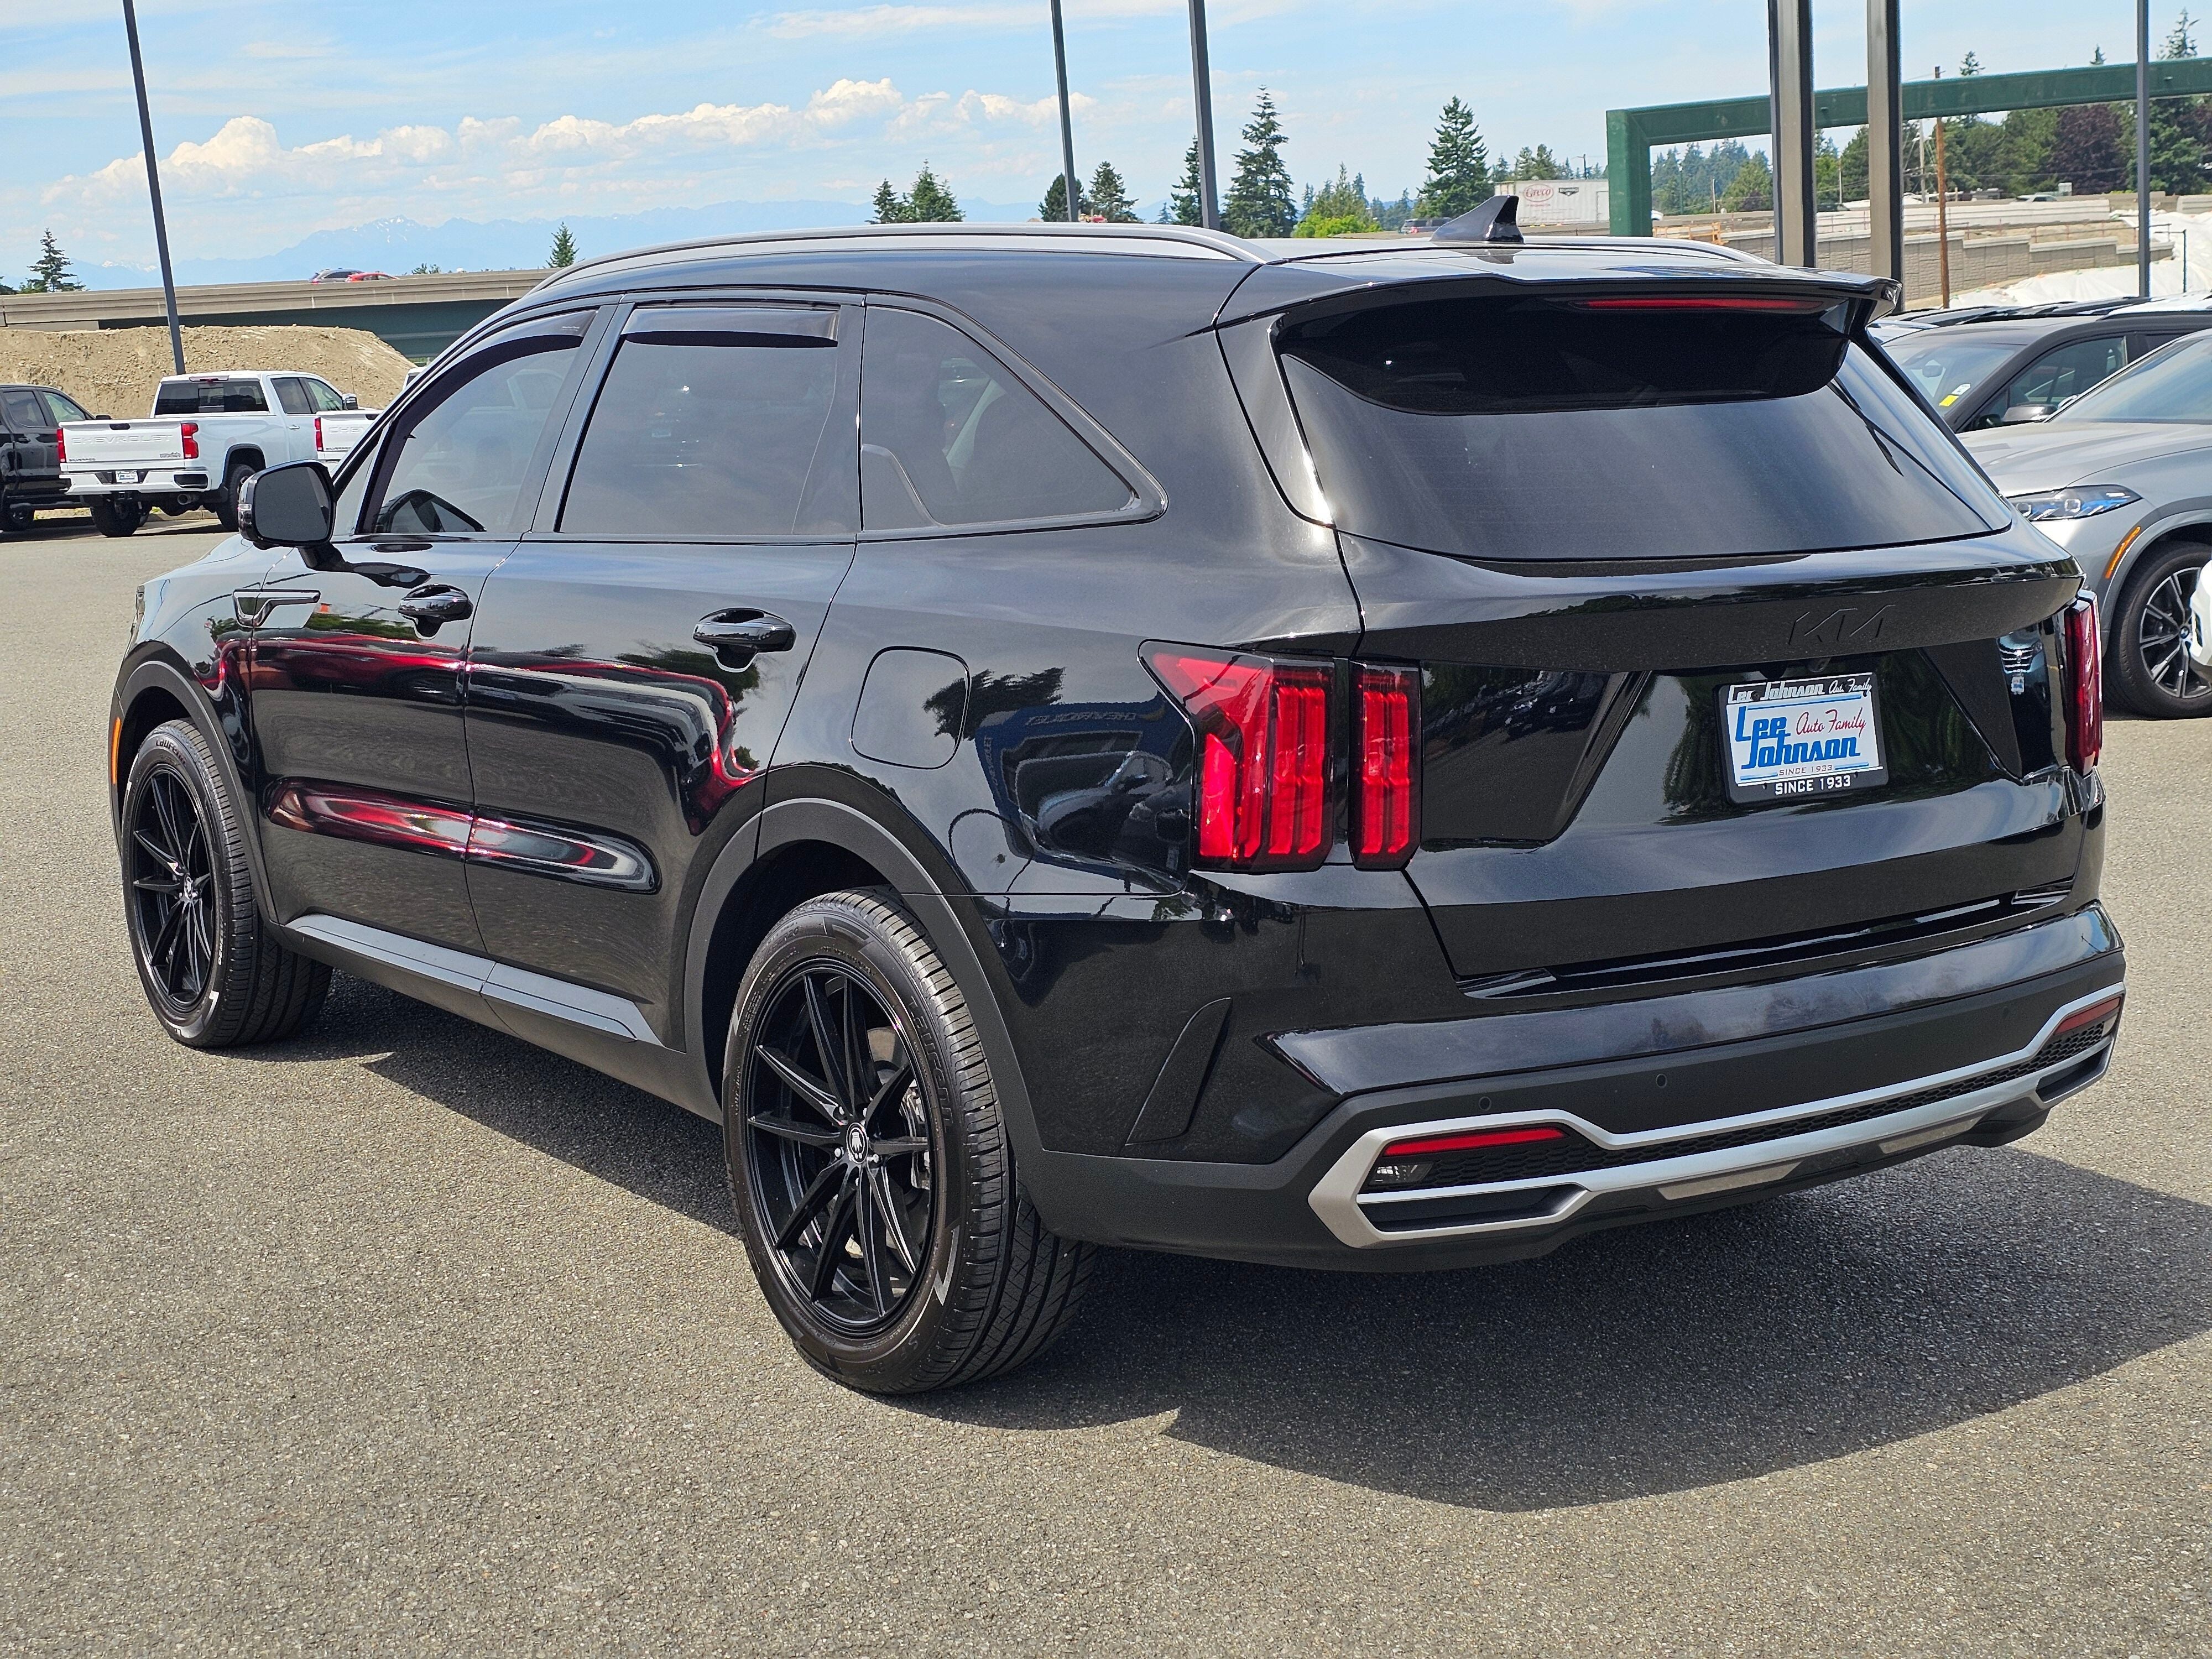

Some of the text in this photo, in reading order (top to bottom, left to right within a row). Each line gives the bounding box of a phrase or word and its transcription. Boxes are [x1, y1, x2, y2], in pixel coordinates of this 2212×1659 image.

[71, 434, 174, 445] CHEVROLET
[1760, 681, 1825, 700] Johnson
[1847, 677, 1872, 696] Family
[1735, 706, 1791, 742] Lee
[1796, 707, 1867, 738] Auto Family
[1741, 730, 1861, 770] Johnson
[1778, 764, 1833, 776] SINCE 1933
[1775, 774, 1851, 795] SINCE 1933
